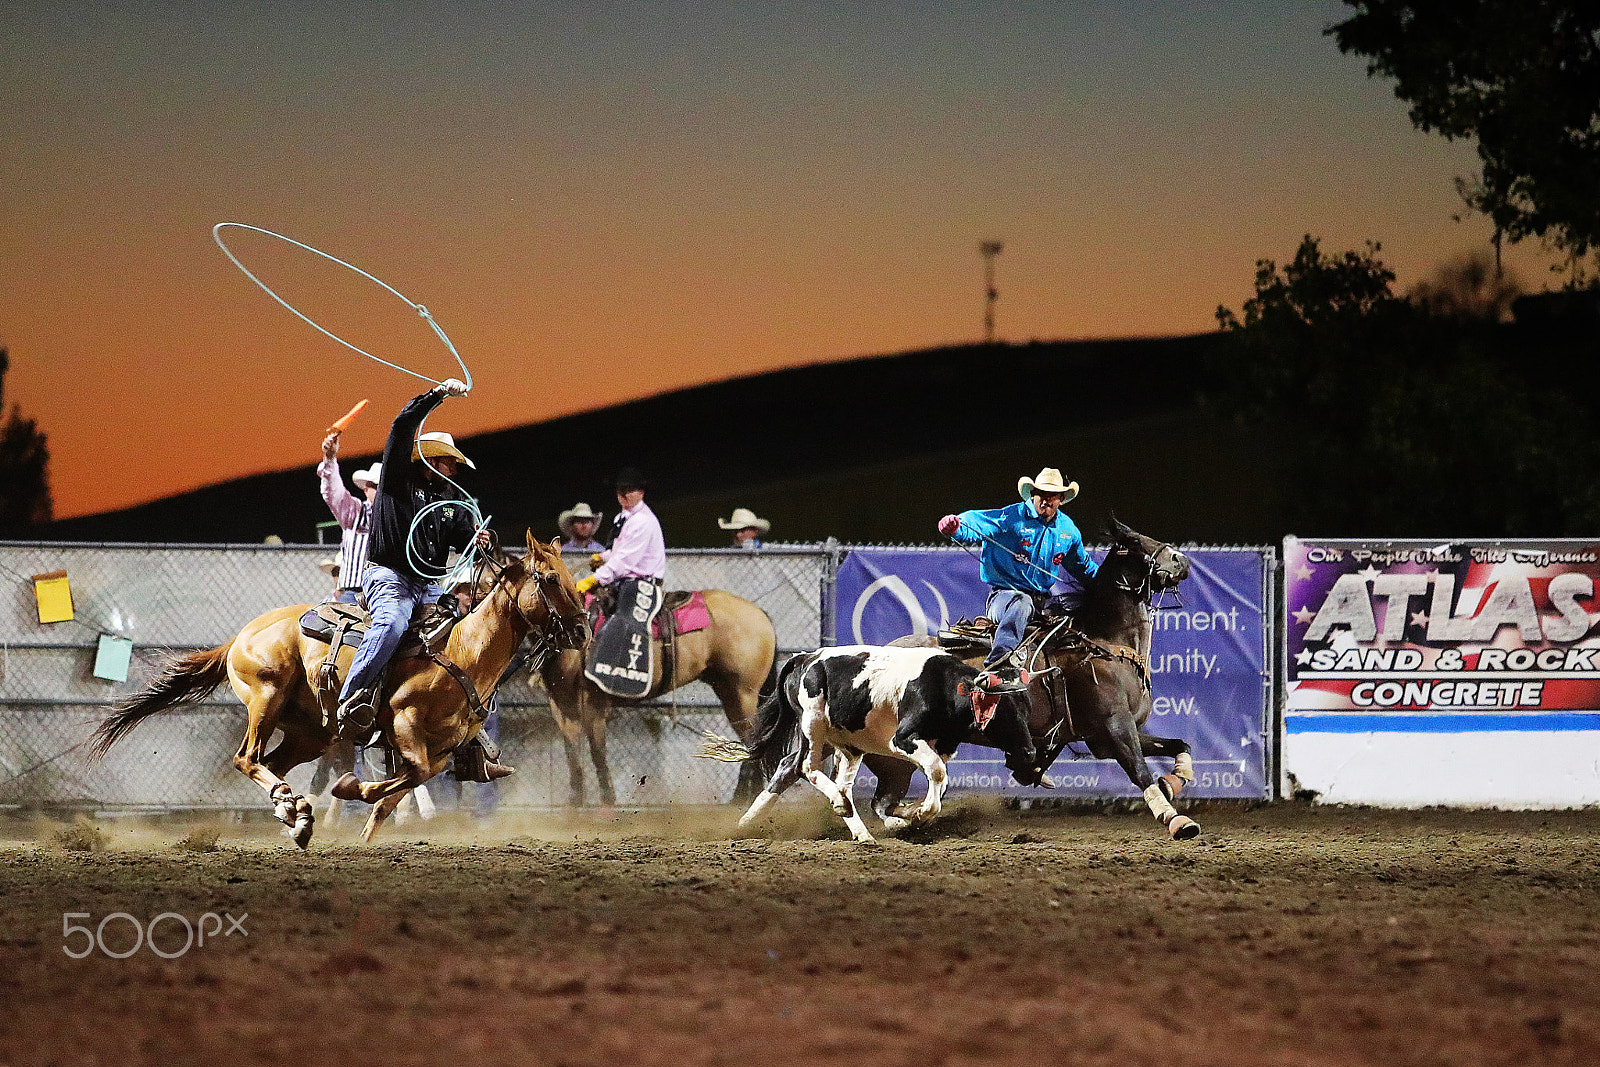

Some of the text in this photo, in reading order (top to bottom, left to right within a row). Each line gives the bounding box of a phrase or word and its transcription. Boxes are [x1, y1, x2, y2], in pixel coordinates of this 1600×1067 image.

[1154, 606, 1246, 631] tment.
[1303, 572, 1594, 642] ATLAS
[1149, 648, 1221, 679] unity.
[1311, 648, 1600, 671] SAND & ROCK
[595, 662, 649, 683] RAM
[1152, 696, 1199, 716] ew.
[1350, 681, 1545, 707] CONCRETE
[948, 773, 1000, 788] wiston
